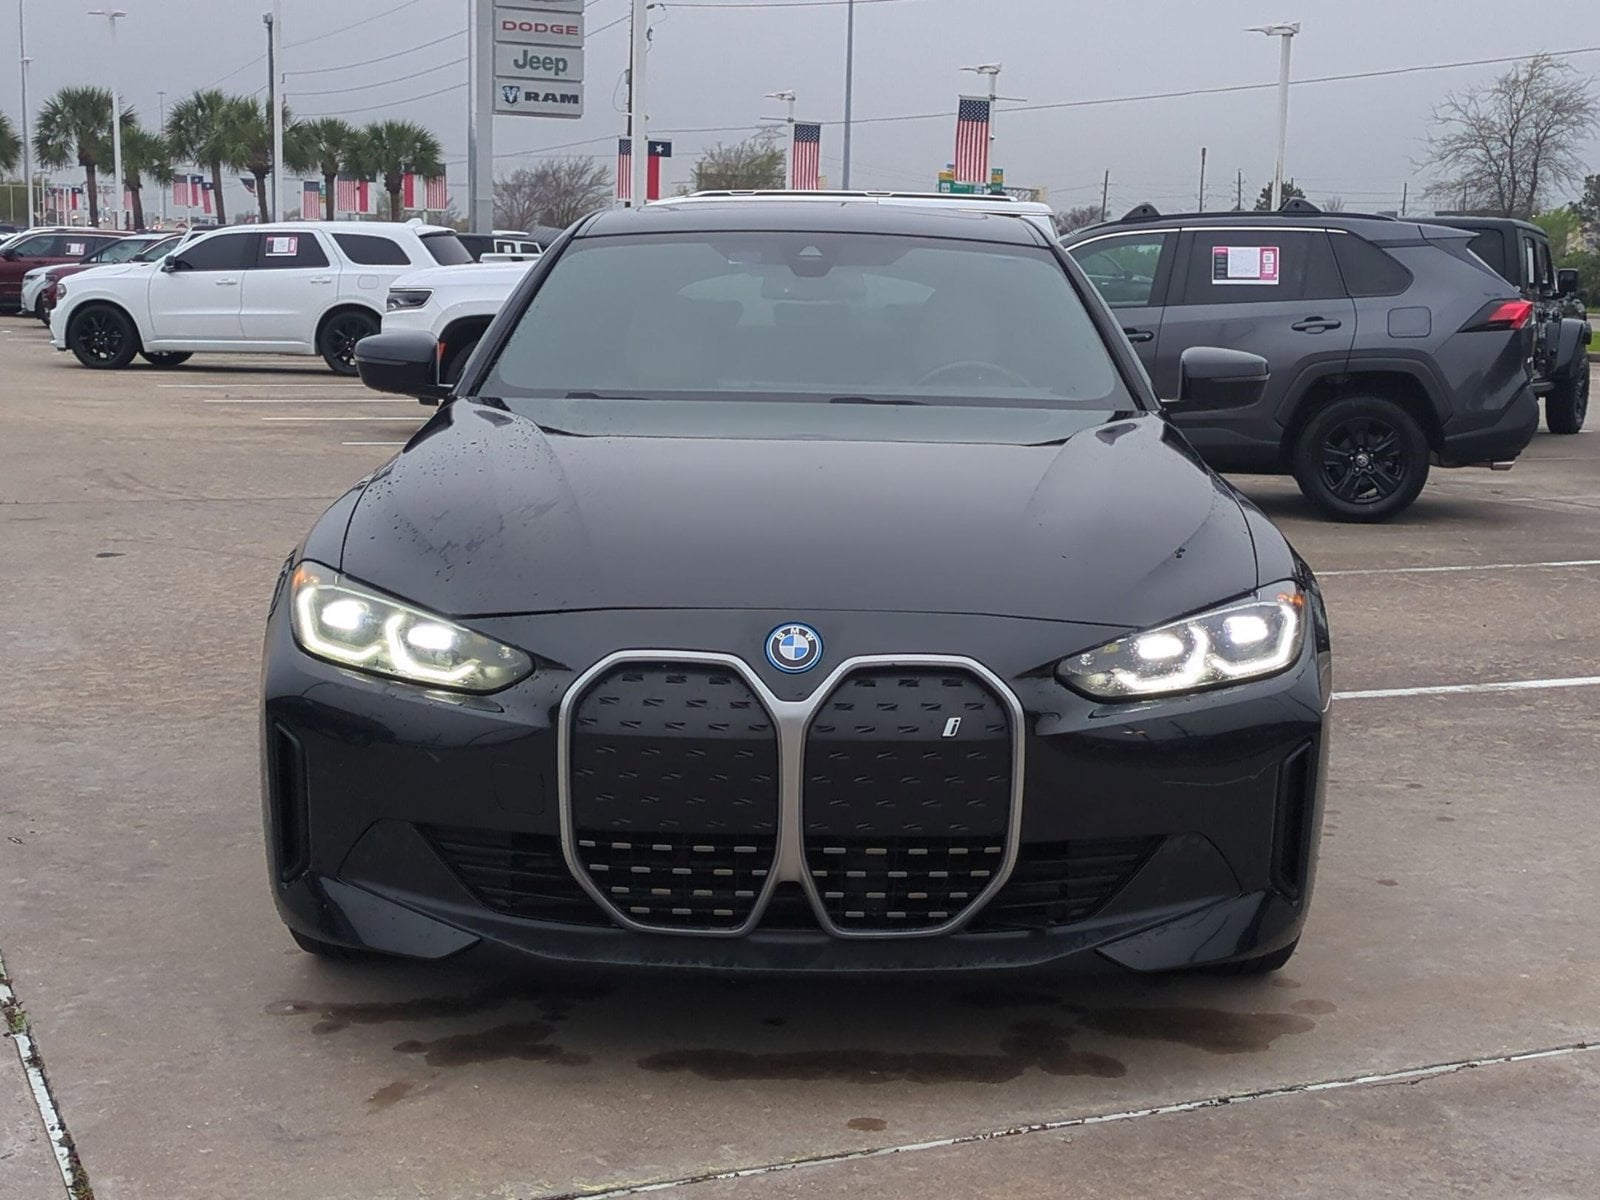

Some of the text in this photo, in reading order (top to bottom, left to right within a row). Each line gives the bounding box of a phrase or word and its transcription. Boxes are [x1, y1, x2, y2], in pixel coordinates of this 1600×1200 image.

[502, 21, 579, 36] DODGE
[513, 49, 568, 76] Jeep
[524, 91, 579, 104] RAM
[775, 626, 815, 641] BMW
